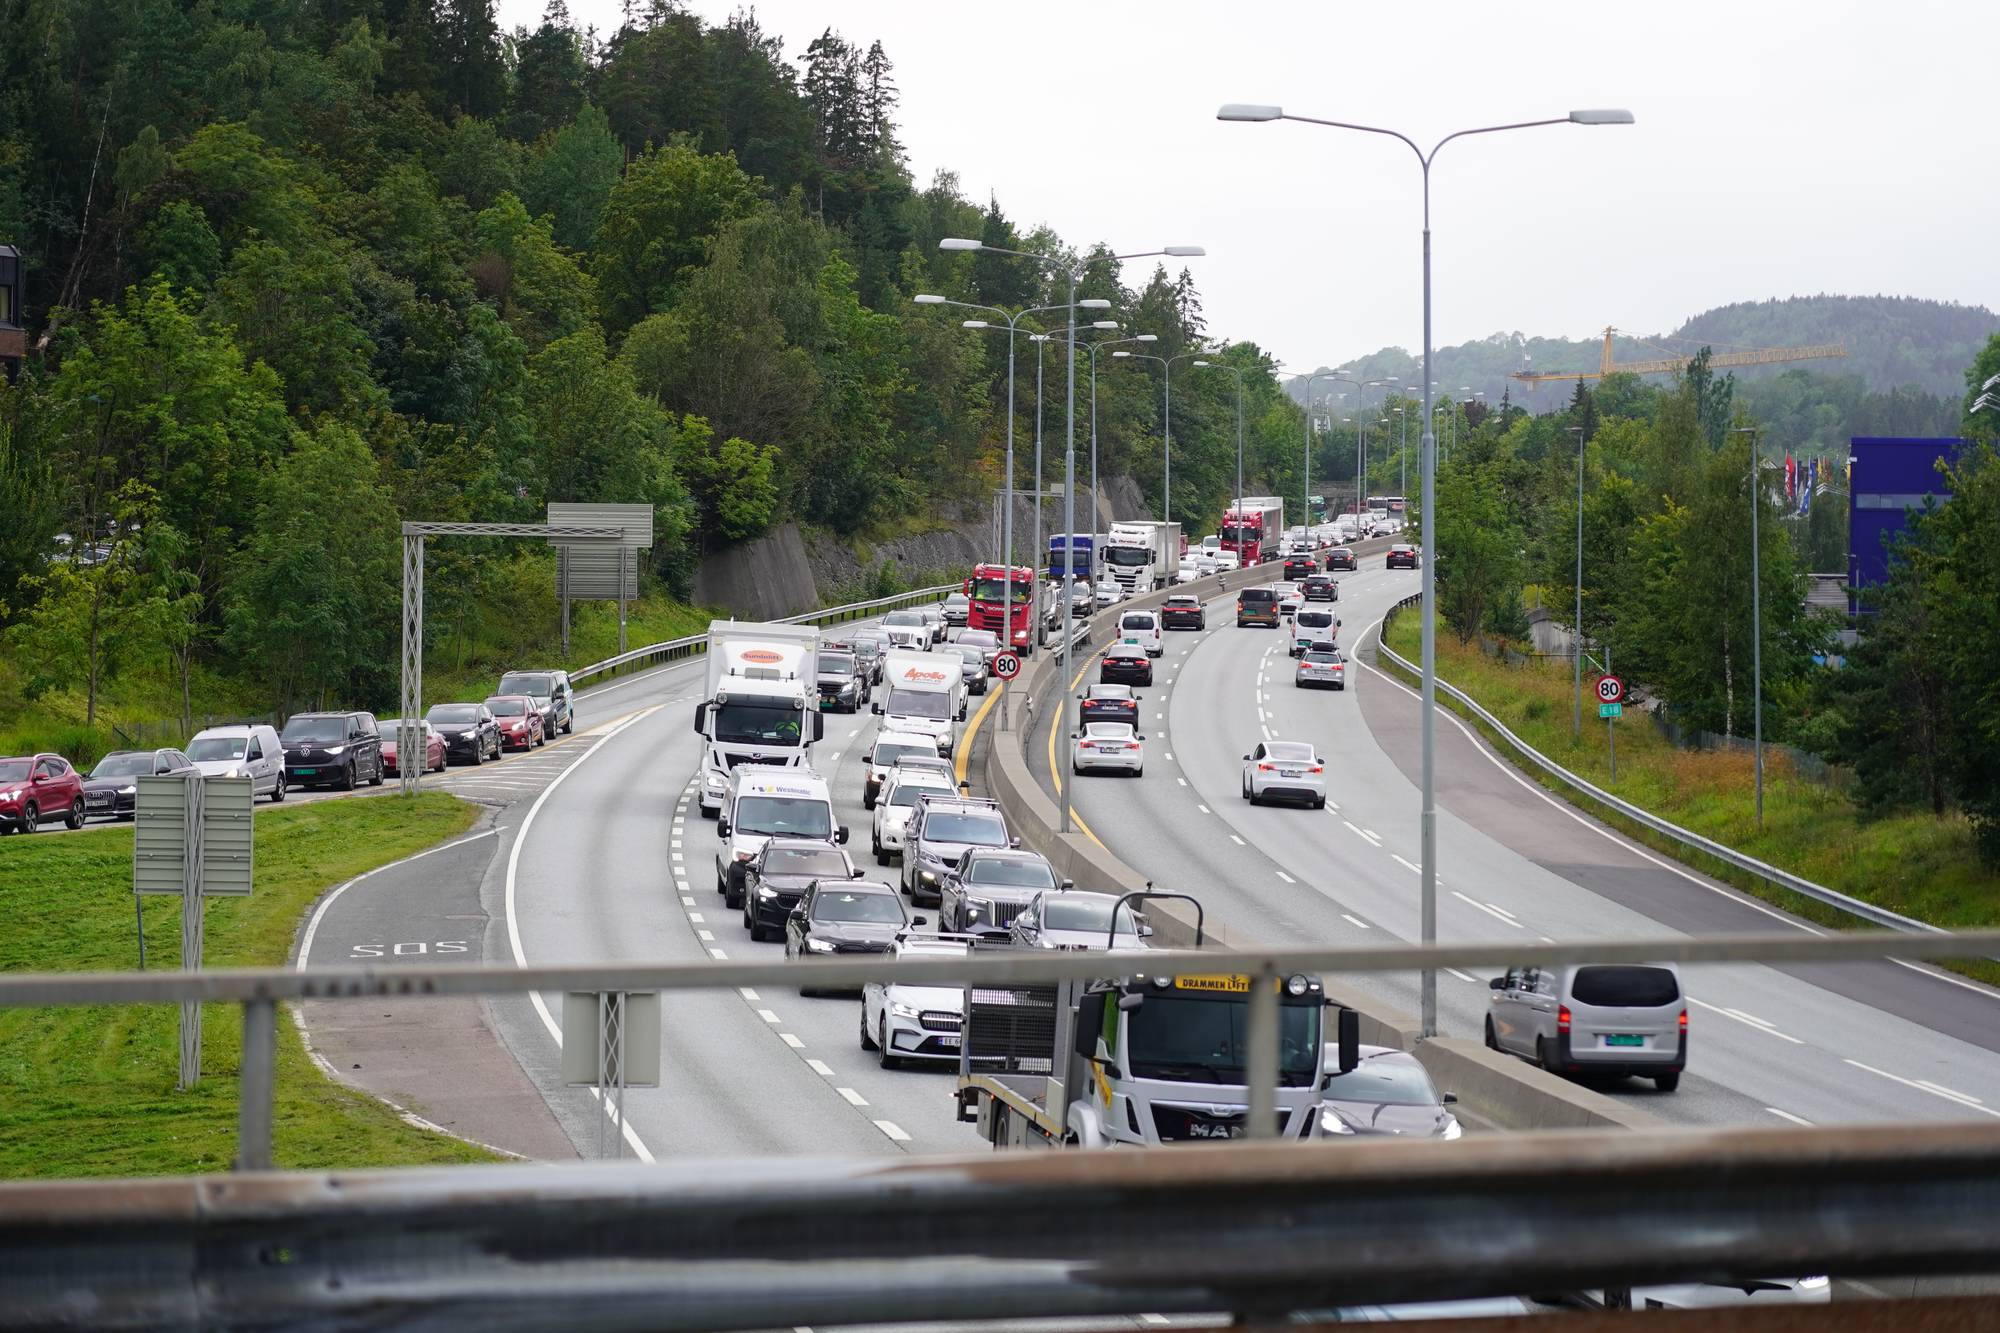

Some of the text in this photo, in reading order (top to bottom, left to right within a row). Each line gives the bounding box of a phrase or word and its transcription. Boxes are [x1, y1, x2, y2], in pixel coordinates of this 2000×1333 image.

[997, 658, 1016, 672] 80
[904, 668, 946, 680] Apollo
[1600, 682, 1619, 697] 80
[350, 941, 468, 958] SOS
[1183, 979, 1225, 988] DRAMMEN
[1190, 1124, 1247, 1138] MAN
